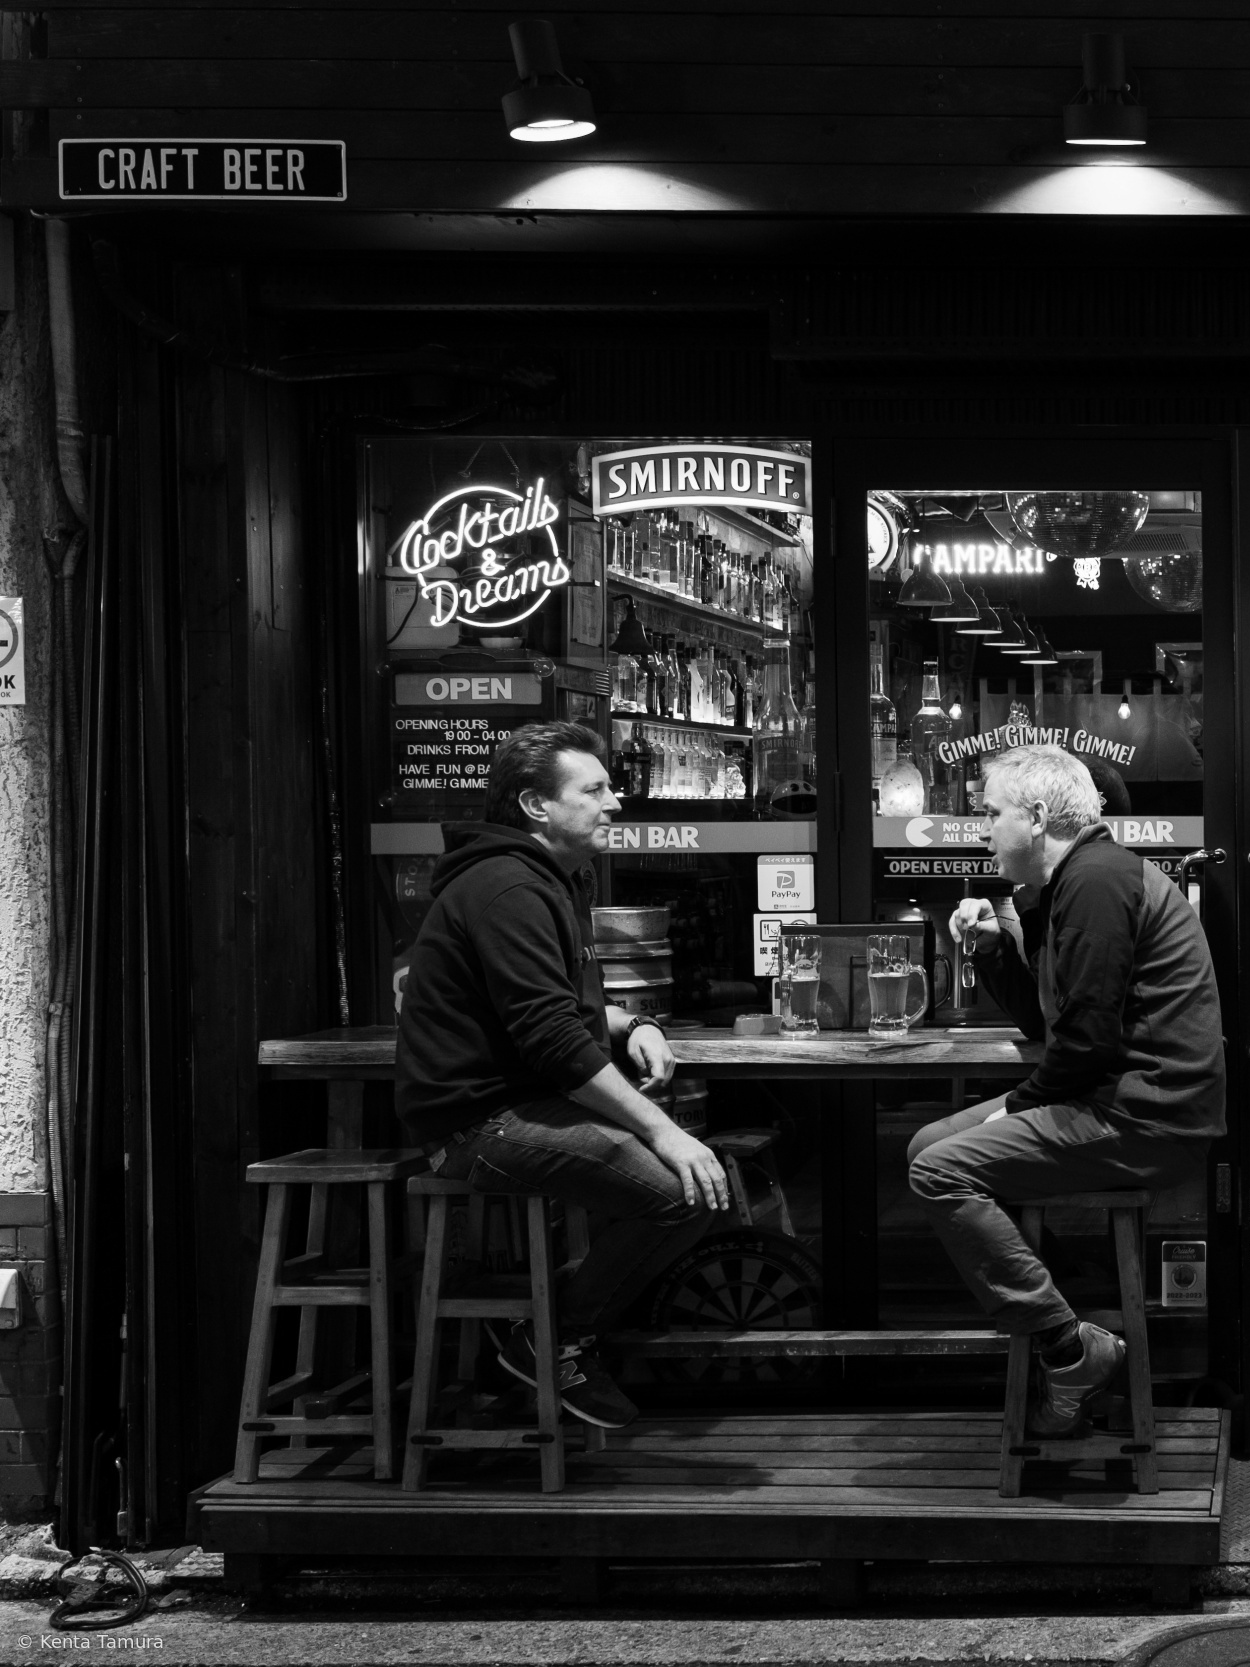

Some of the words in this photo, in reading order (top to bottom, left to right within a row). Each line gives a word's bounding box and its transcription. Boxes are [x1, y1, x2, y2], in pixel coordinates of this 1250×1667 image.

[98, 148, 199, 190] CRAFT
[224, 149, 305, 191] BEER
[608, 457, 795, 499] SMIRNOFF
[401, 478, 559, 574] Cocktails
[421, 557, 569, 627] Dreams
[426, 678, 512, 700] OPEN
[395, 720, 448, 730] OPENING
[450, 720, 489, 730] HOURS
[407, 745, 451, 755] DRINKS
[455, 745, 490, 755] FROM
[938, 728, 1001, 764] GIMME!
[1005, 725, 1069, 748] GIMME!
[1073, 730, 1136, 766] GIMME!
[399, 764, 430, 775] HAVE
[436, 764, 461, 775] FUN
[403, 778, 447, 789] GIMME!
[450, 778, 489, 789] GIMME
[943, 823, 960, 832] NO
[1123, 821, 1174, 842] BAR
[648, 826, 700, 848] BAR
[942, 833, 960, 843] ALL
[889, 861, 930, 873] OPEN
[933, 861, 981, 873] EVERY
[983, 861, 999, 873] DA
[771, 891, 801, 899] PayPay
